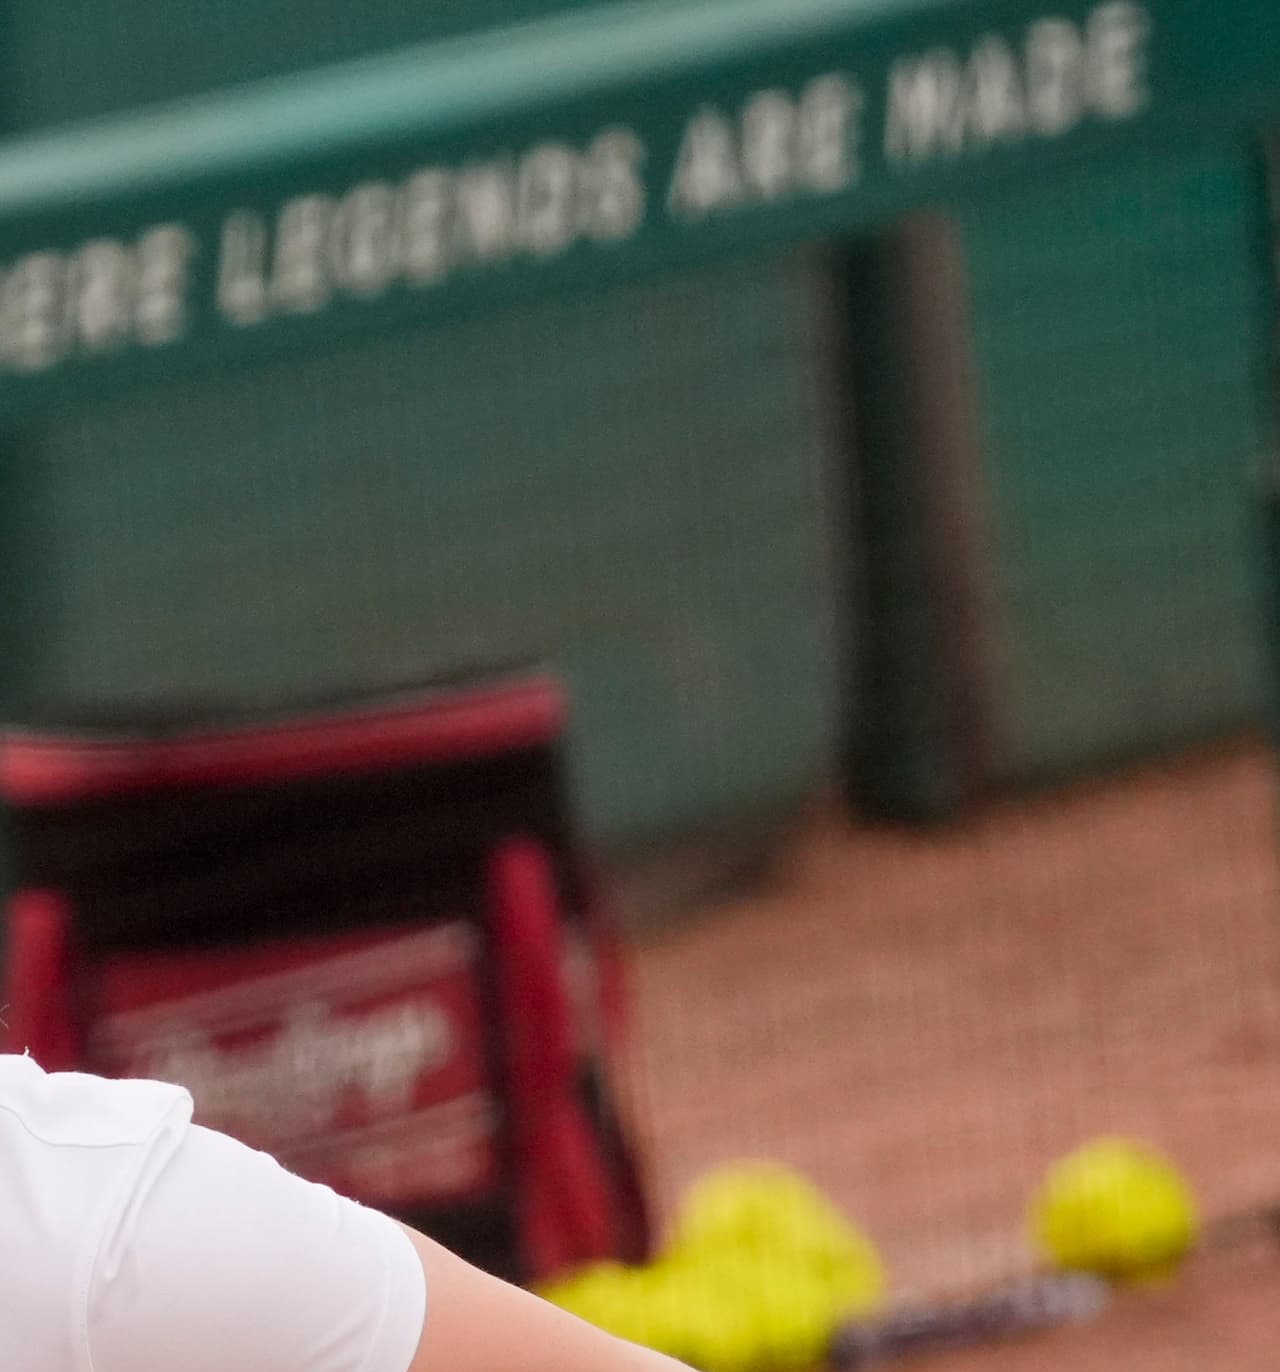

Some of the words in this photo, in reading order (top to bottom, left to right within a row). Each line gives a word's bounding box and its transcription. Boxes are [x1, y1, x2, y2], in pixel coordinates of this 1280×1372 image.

[218, 128, 646, 326] LEGENDS
[668, 70, 866, 222] ARE
[884, 2, 1148, 170] MADE
